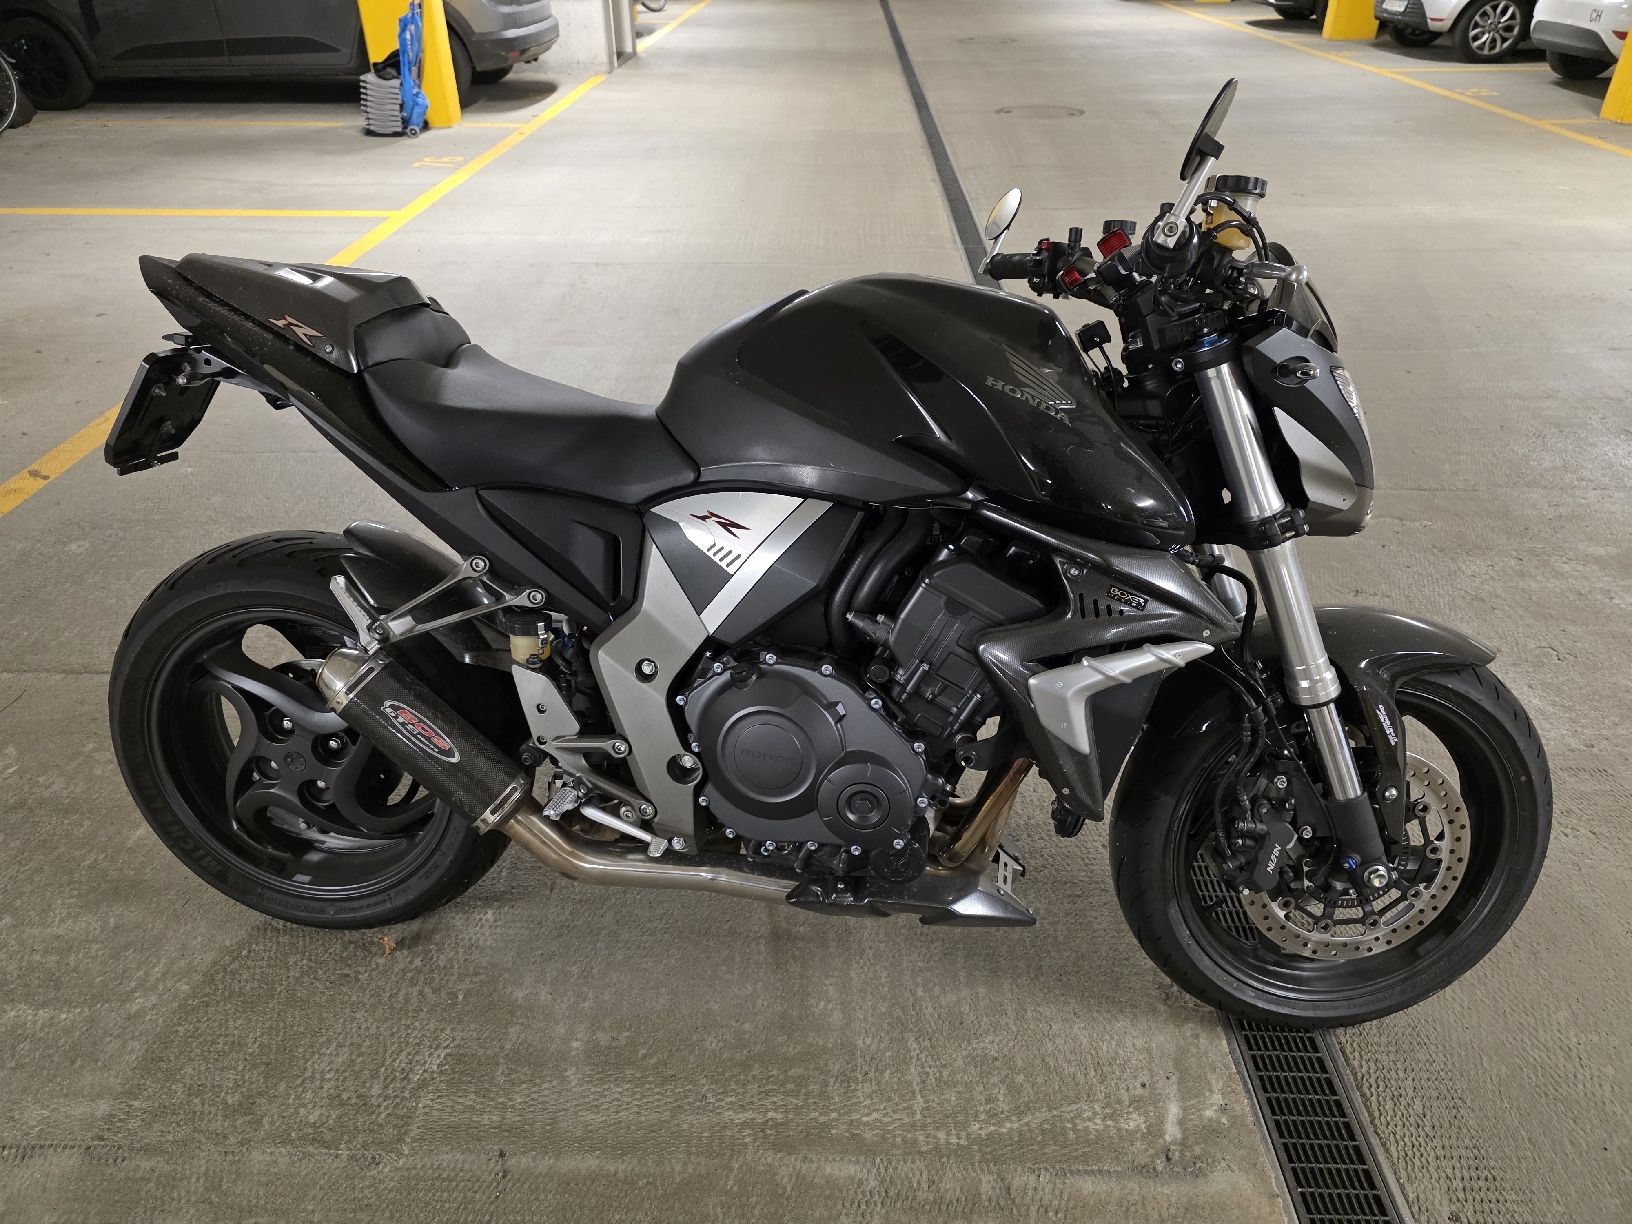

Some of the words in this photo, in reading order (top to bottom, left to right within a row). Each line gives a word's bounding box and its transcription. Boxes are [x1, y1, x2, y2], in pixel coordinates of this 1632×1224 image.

[1589, 8, 1604, 23] CH
[267, 313, 328, 348] R
[985, 375, 1072, 427] HONDA
[689, 509, 752, 540] R
[397, 709, 451, 751] BOS
